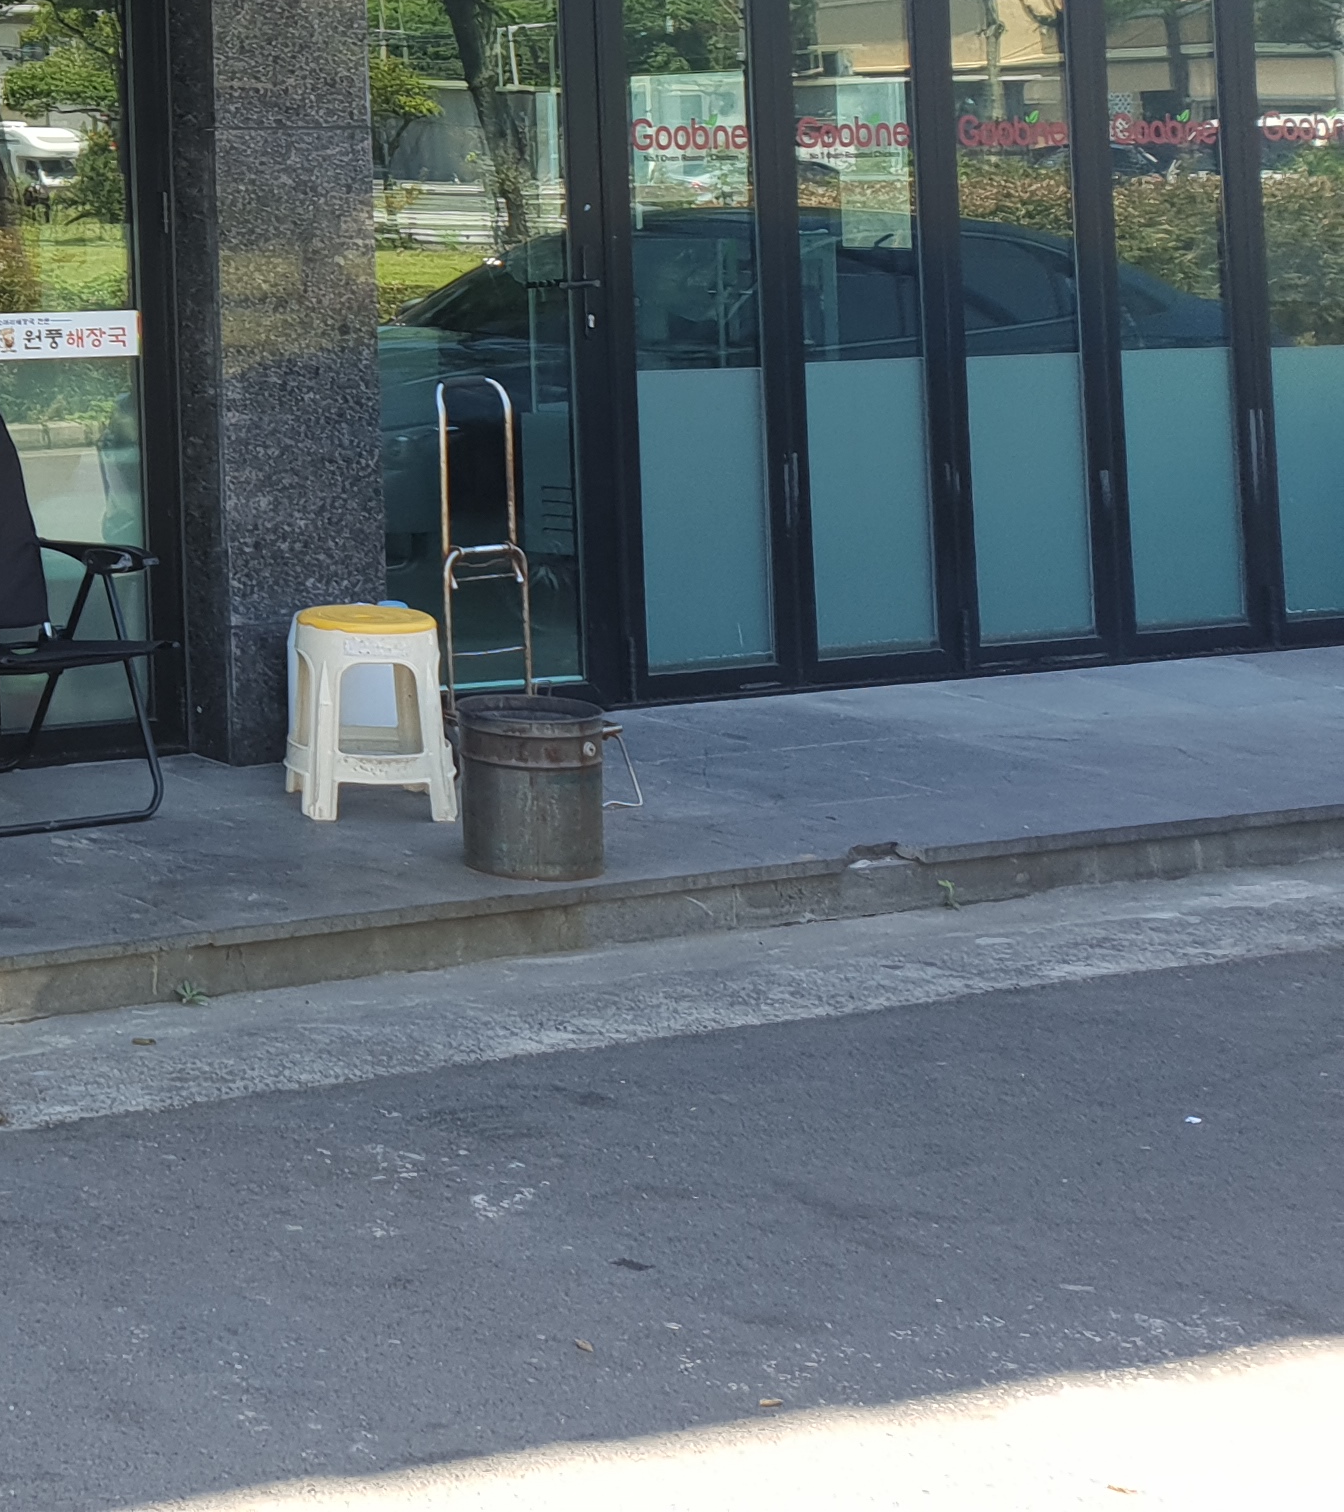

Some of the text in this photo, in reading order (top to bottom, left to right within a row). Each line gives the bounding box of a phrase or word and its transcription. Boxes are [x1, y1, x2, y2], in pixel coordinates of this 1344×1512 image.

[632, 117, 749, 151] Goobne
[798, 116, 911, 148] Goobne
[958, 114, 1067, 147] Goobne
[1113, 113, 1220, 144] Goobne
[23, 326, 128, 350] 원풍해장국
